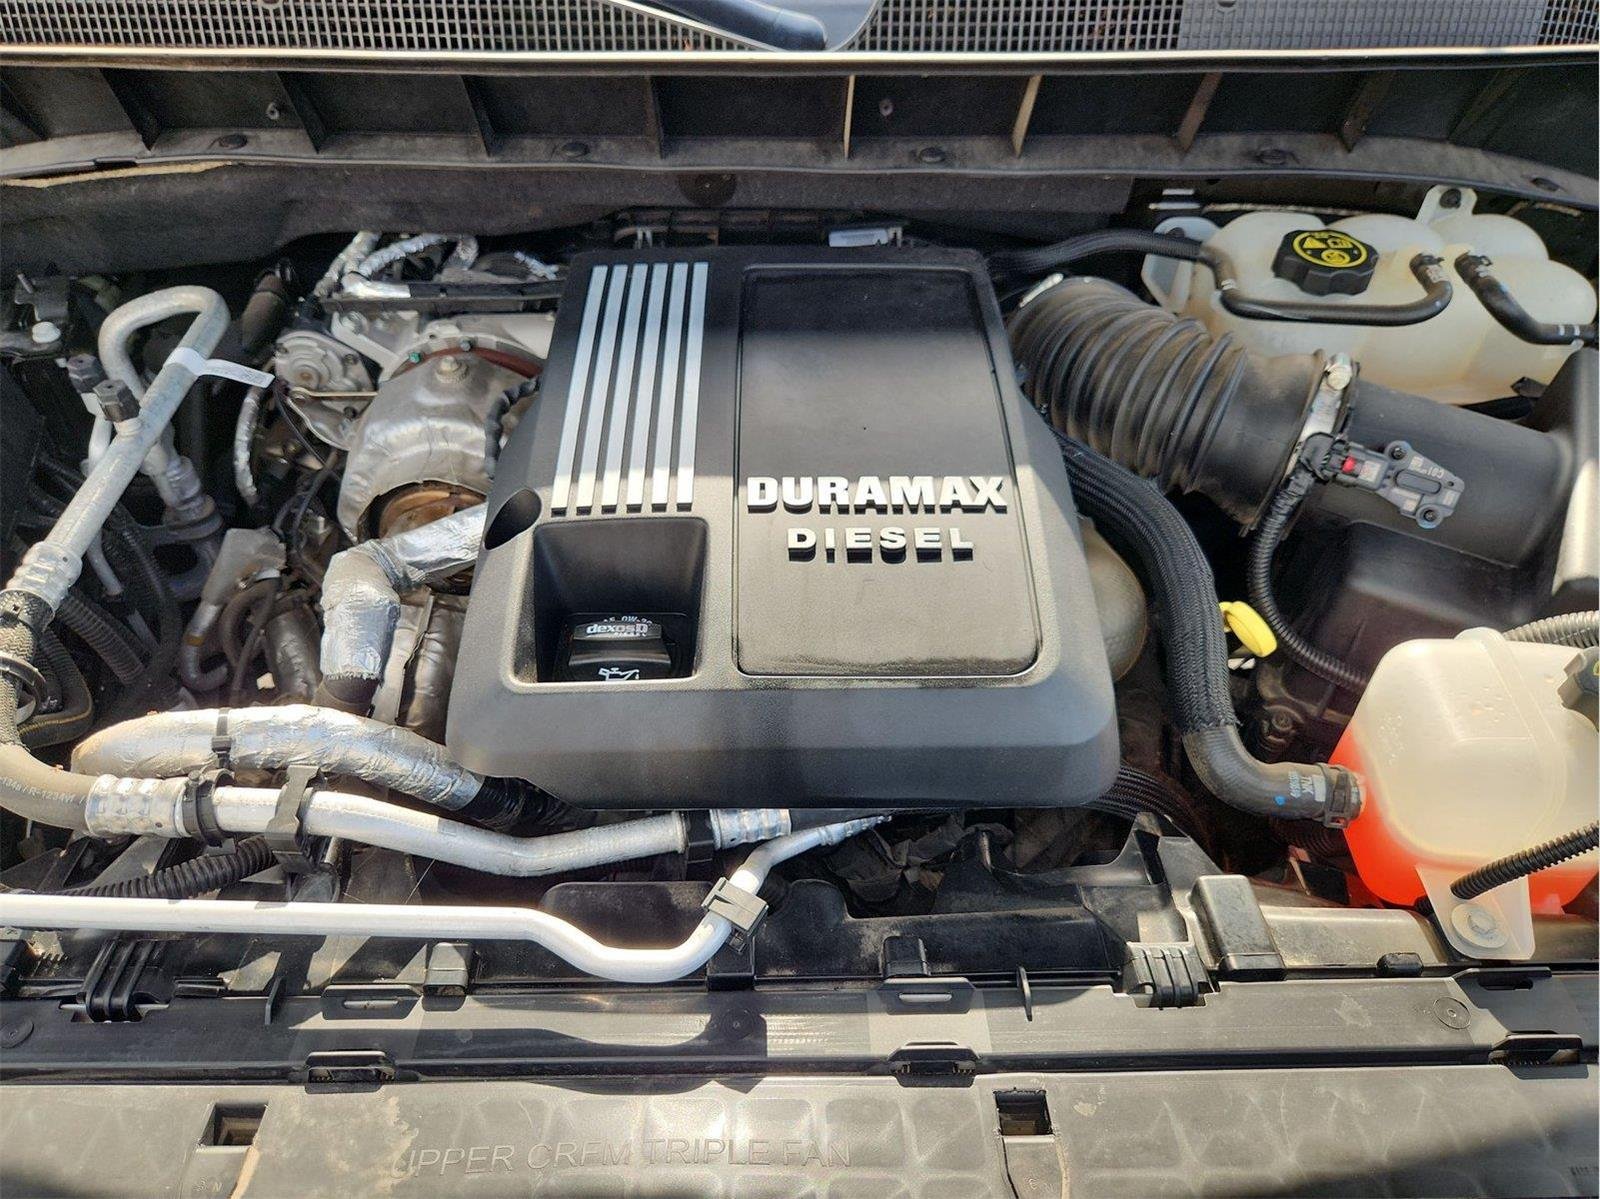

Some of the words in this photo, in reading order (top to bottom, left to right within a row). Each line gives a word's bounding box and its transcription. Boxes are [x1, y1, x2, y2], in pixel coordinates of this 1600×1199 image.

[747, 476, 1007, 511] DURAMAX
[787, 527, 974, 557] DIESEL
[391, 1145, 515, 1179] UPPER
[644, 1137, 772, 1167] TRIPLE
[781, 1138, 852, 1168] FAN
